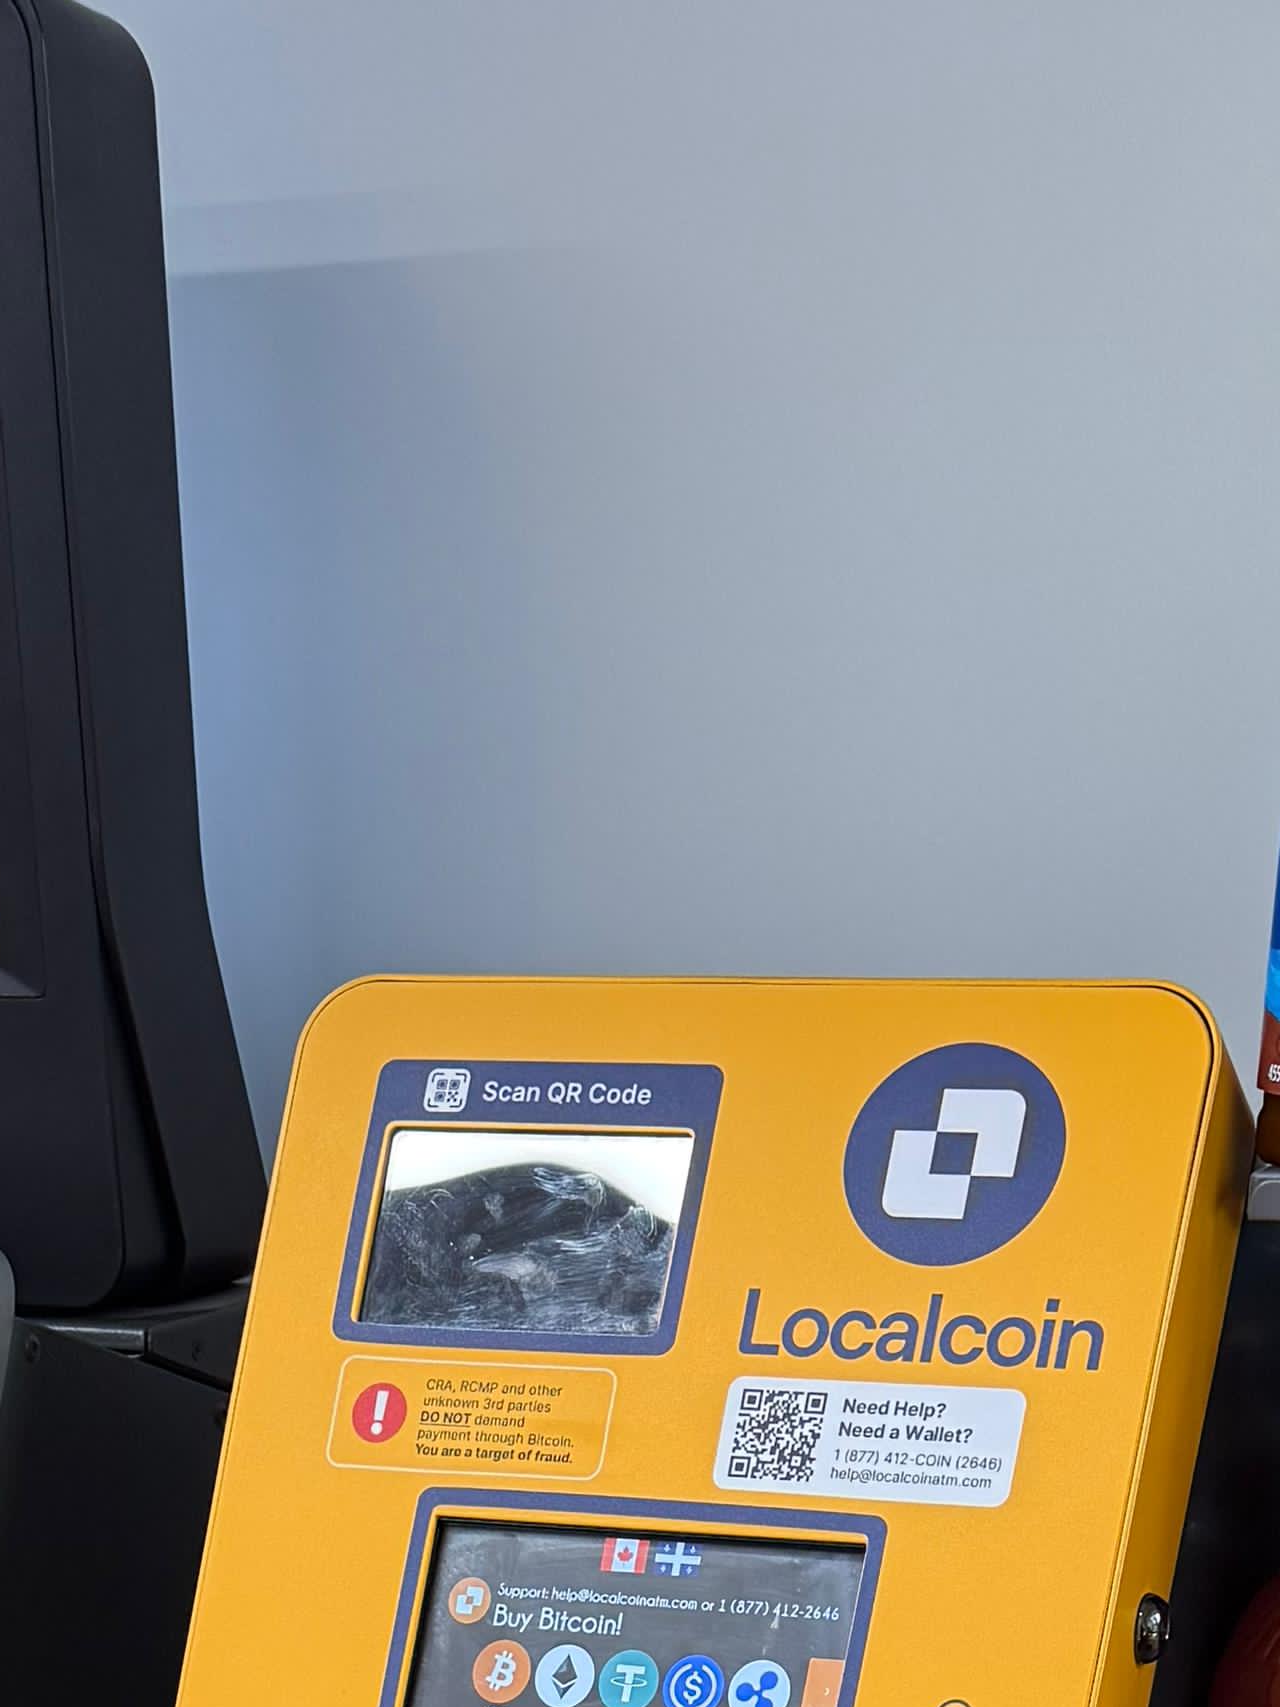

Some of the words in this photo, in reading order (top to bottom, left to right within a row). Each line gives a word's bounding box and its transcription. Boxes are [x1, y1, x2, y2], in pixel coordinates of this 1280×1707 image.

[481, 1081, 543, 1105] Scan
[548, 1082, 583, 1105] QR
[588, 1082, 652, 1107] Code
[737, 1287, 1105, 1371] Localcoin
[426, 1378, 456, 1393] CRA,
[460, 1380, 498, 1393] RCMP
[501, 1382, 524, 1395] and
[529, 1384, 563, 1397] other
[423, 1396, 479, 1409] unknown
[483, 1398, 504, 1410] 3rd
[507, 1400, 551, 1413] parties
[842, 1398, 889, 1415] Need
[893, 1400, 947, 1421] Help?
[420, 1411, 439, 1424] DO
[443, 1412, 471, 1426] NOT
[474, 1414, 525, 1428] demand
[417, 1428, 470, 1444] payment
[475, 1430, 523, 1445] through
[528, 1432, 574, 1448] Bitcoin.
[838, 1421, 885, 1439] Need
[889, 1426, 900, 1439] a
[905, 1425, 973, 1444] Wallet?
[416, 1443, 446, 1457] You
[448, 1446, 462, 1457] are
[464, 1447, 472, 1458] a
[476, 1446, 514, 1461] target
[518, 1449, 532, 1460] of
[535, 1450, 572, 1464] fraud.
[845, 1449, 880, 1465] (877)
[884, 1451, 951, 1468] 412-COIN
[955, 1456, 1002, 1473] (2646)
[830, 1467, 992, 1489] help@localcoinatm.com
[498, 1582, 549, 1601] Support:
[551, 1586, 698, 1612] help@localcoinatm.com
[703, 1600, 714, 1612] or
[730, 1599, 769, 1617] (877)
[773, 1603, 840, 1621] 412-2646
[493, 1604, 530, 1634] Buy
[539, 1607, 624, 1636] Bitcoin!
